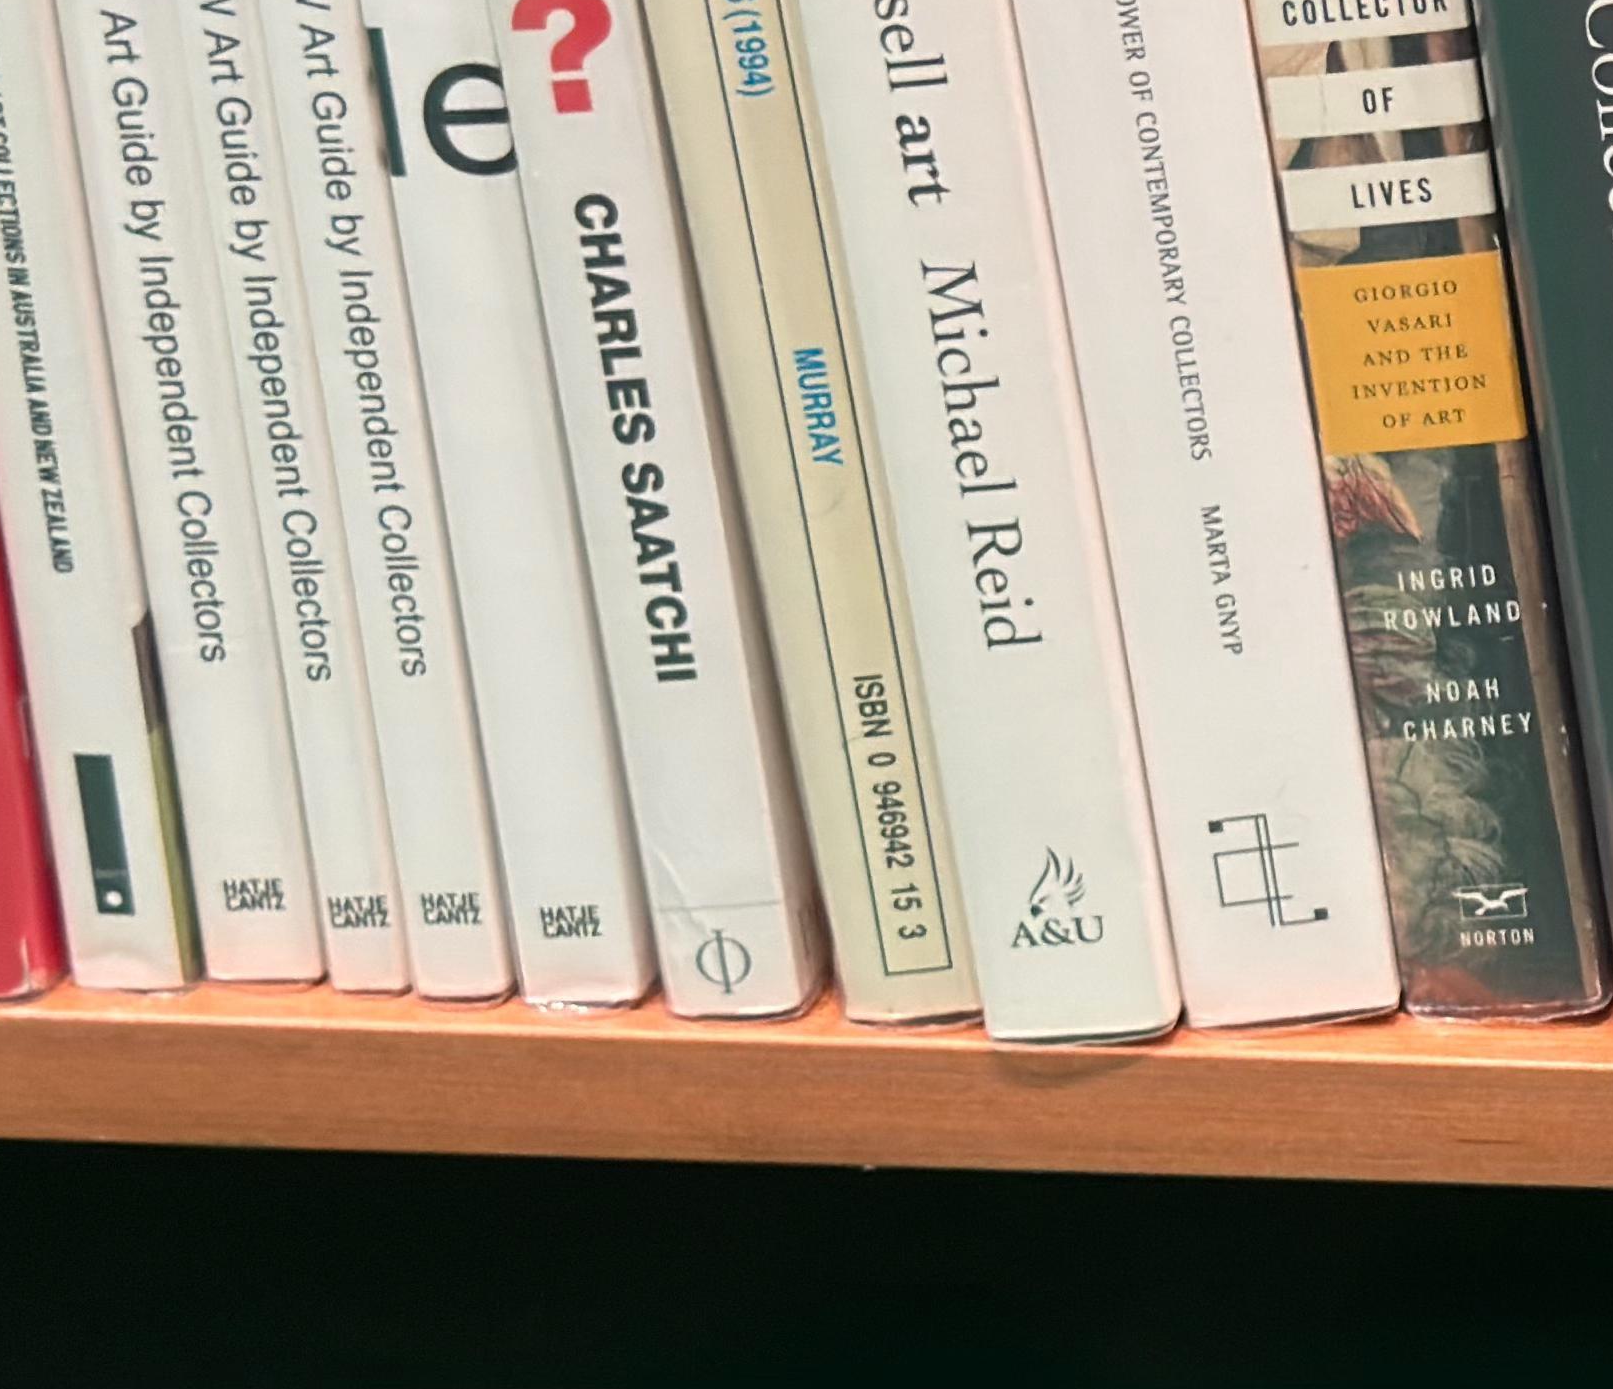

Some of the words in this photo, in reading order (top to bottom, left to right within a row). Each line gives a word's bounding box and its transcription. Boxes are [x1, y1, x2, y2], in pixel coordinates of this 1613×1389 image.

[299, 23, 338, 78] Art
[721, 10, 776, 98] (1994)
[1361, 86, 1394, 114] OF
[311, 92, 356, 200] Guide
[895, 114, 944, 207] art
[1350, 178, 1433, 209] LIVES
[325, 214, 364, 256] by
[1353, 278, 1458, 304] GIORGIO
[1367, 312, 1453, 332] VASARI
[1362, 348, 1410, 366] AND
[1419, 344, 1468, 362] THE
[339, 270, 405, 493] Independent
[919, 260, 1016, 485] Michael
[1351, 374, 1487, 400] INVENTION
[1382, 411, 1412, 429] OF
[1422, 407, 1466, 425] ART
[573, 192, 655, 445] CHARLES
[620, 461, 697, 685] SAATCHI
[377, 505, 426, 676] Collectors
[967, 515, 1043, 652] Reid
[1397, 564, 1496, 592] INGRID
[1384, 600, 1521, 630] ROWLAND
[1425, 678, 1499, 702] NOAH
[1403, 712, 1532, 743] CHARNEY
[1011, 916, 1106, 950] A&U
[1460, 928, 1534, 947] NORTON
